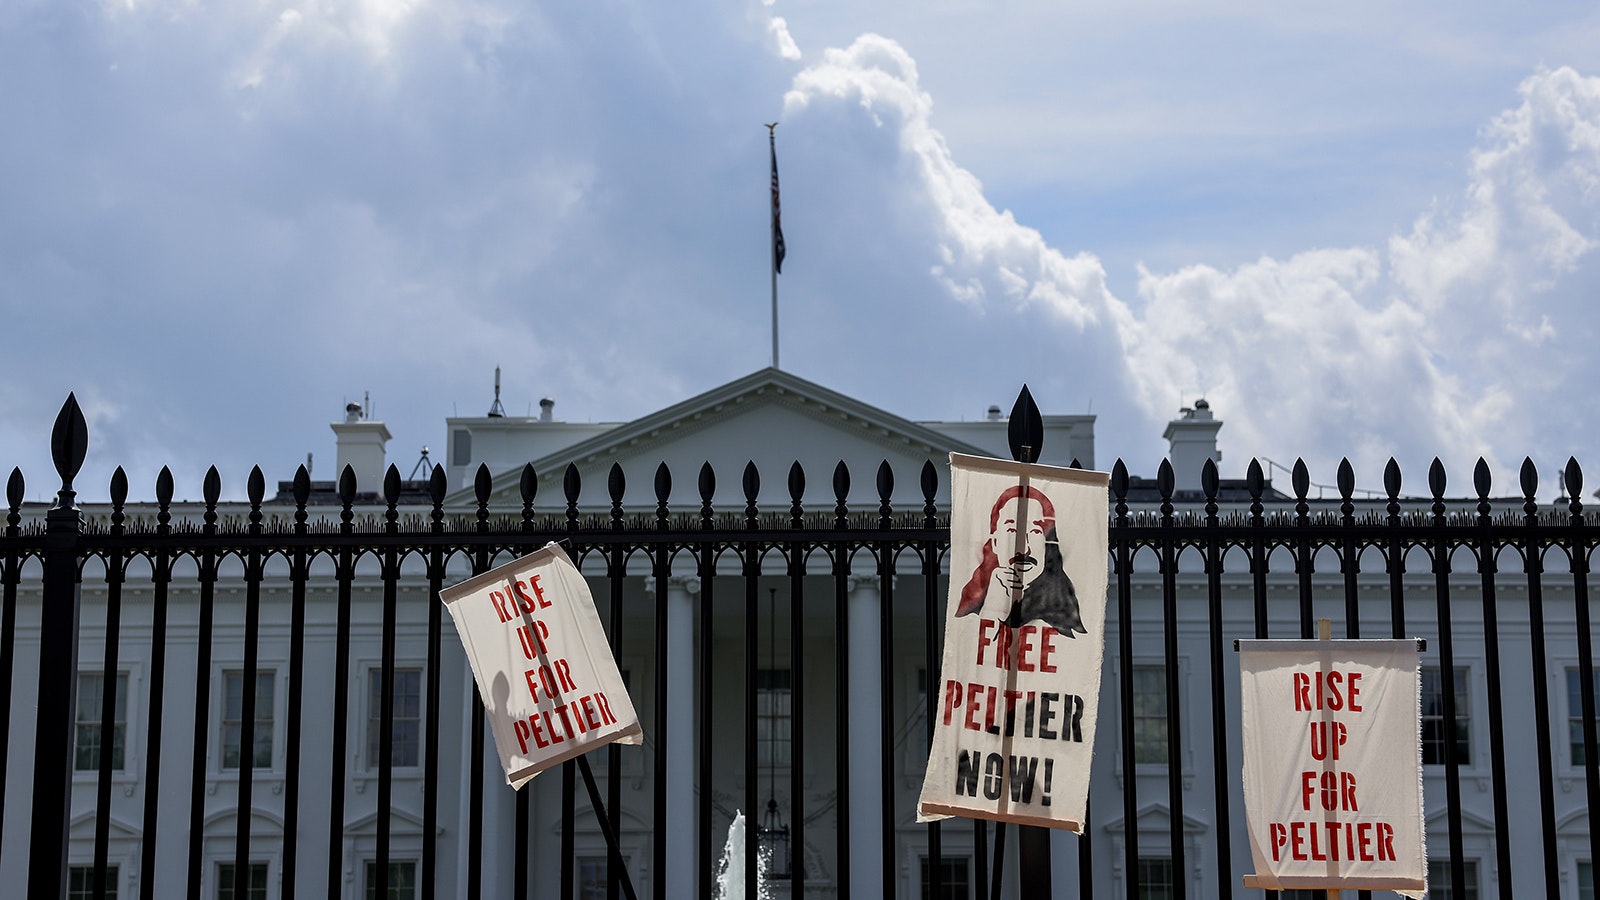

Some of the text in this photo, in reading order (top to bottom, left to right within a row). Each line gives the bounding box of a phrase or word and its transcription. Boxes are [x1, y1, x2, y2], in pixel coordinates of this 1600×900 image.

[489, 574, 553, 624] RISE
[516, 619, 550, 661] UP
[976, 619, 1059, 673] FREE
[523, 658, 578, 704] FOR
[1293, 672, 1363, 712] RISE
[513, 692, 617, 754] PELTIER
[944, 680, 1084, 743] PELTIER
[1310, 721, 1348, 761] UP
[954, 749, 1053, 806] NOW!
[1301, 770, 1358, 812] FOR
[1269, 821, 1396, 862] PELTIER
